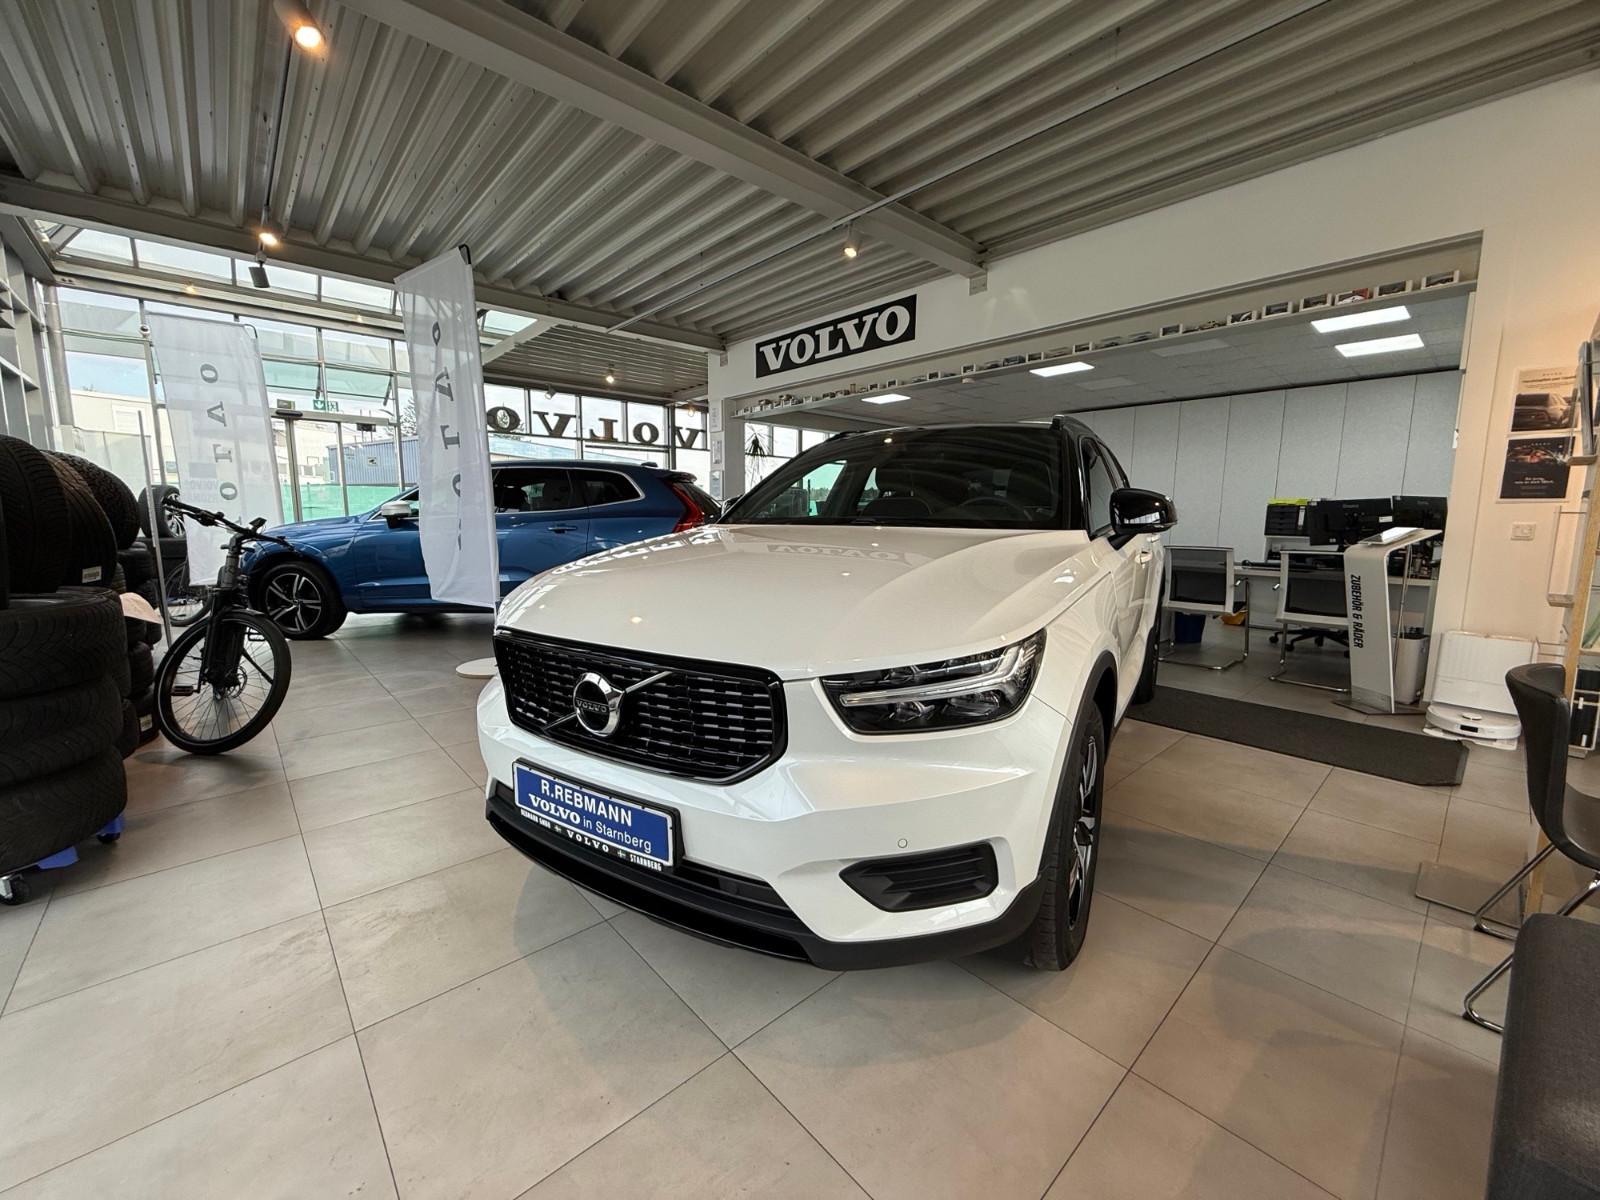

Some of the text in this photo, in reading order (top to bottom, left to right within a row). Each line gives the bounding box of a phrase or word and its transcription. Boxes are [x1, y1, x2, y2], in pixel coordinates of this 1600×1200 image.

[759, 304, 911, 371] VOLVO
[1350, 574, 1364, 612] ZUBEHÖR
[1352, 621, 1366, 648] RÄDER
[528, 793, 581, 825] VOLVO
[582, 815, 593, 830] in
[595, 821, 653, 854] Starnberg
[540, 778, 632, 827] R.REBMANN
[566, 829, 609, 853] VOLVO
